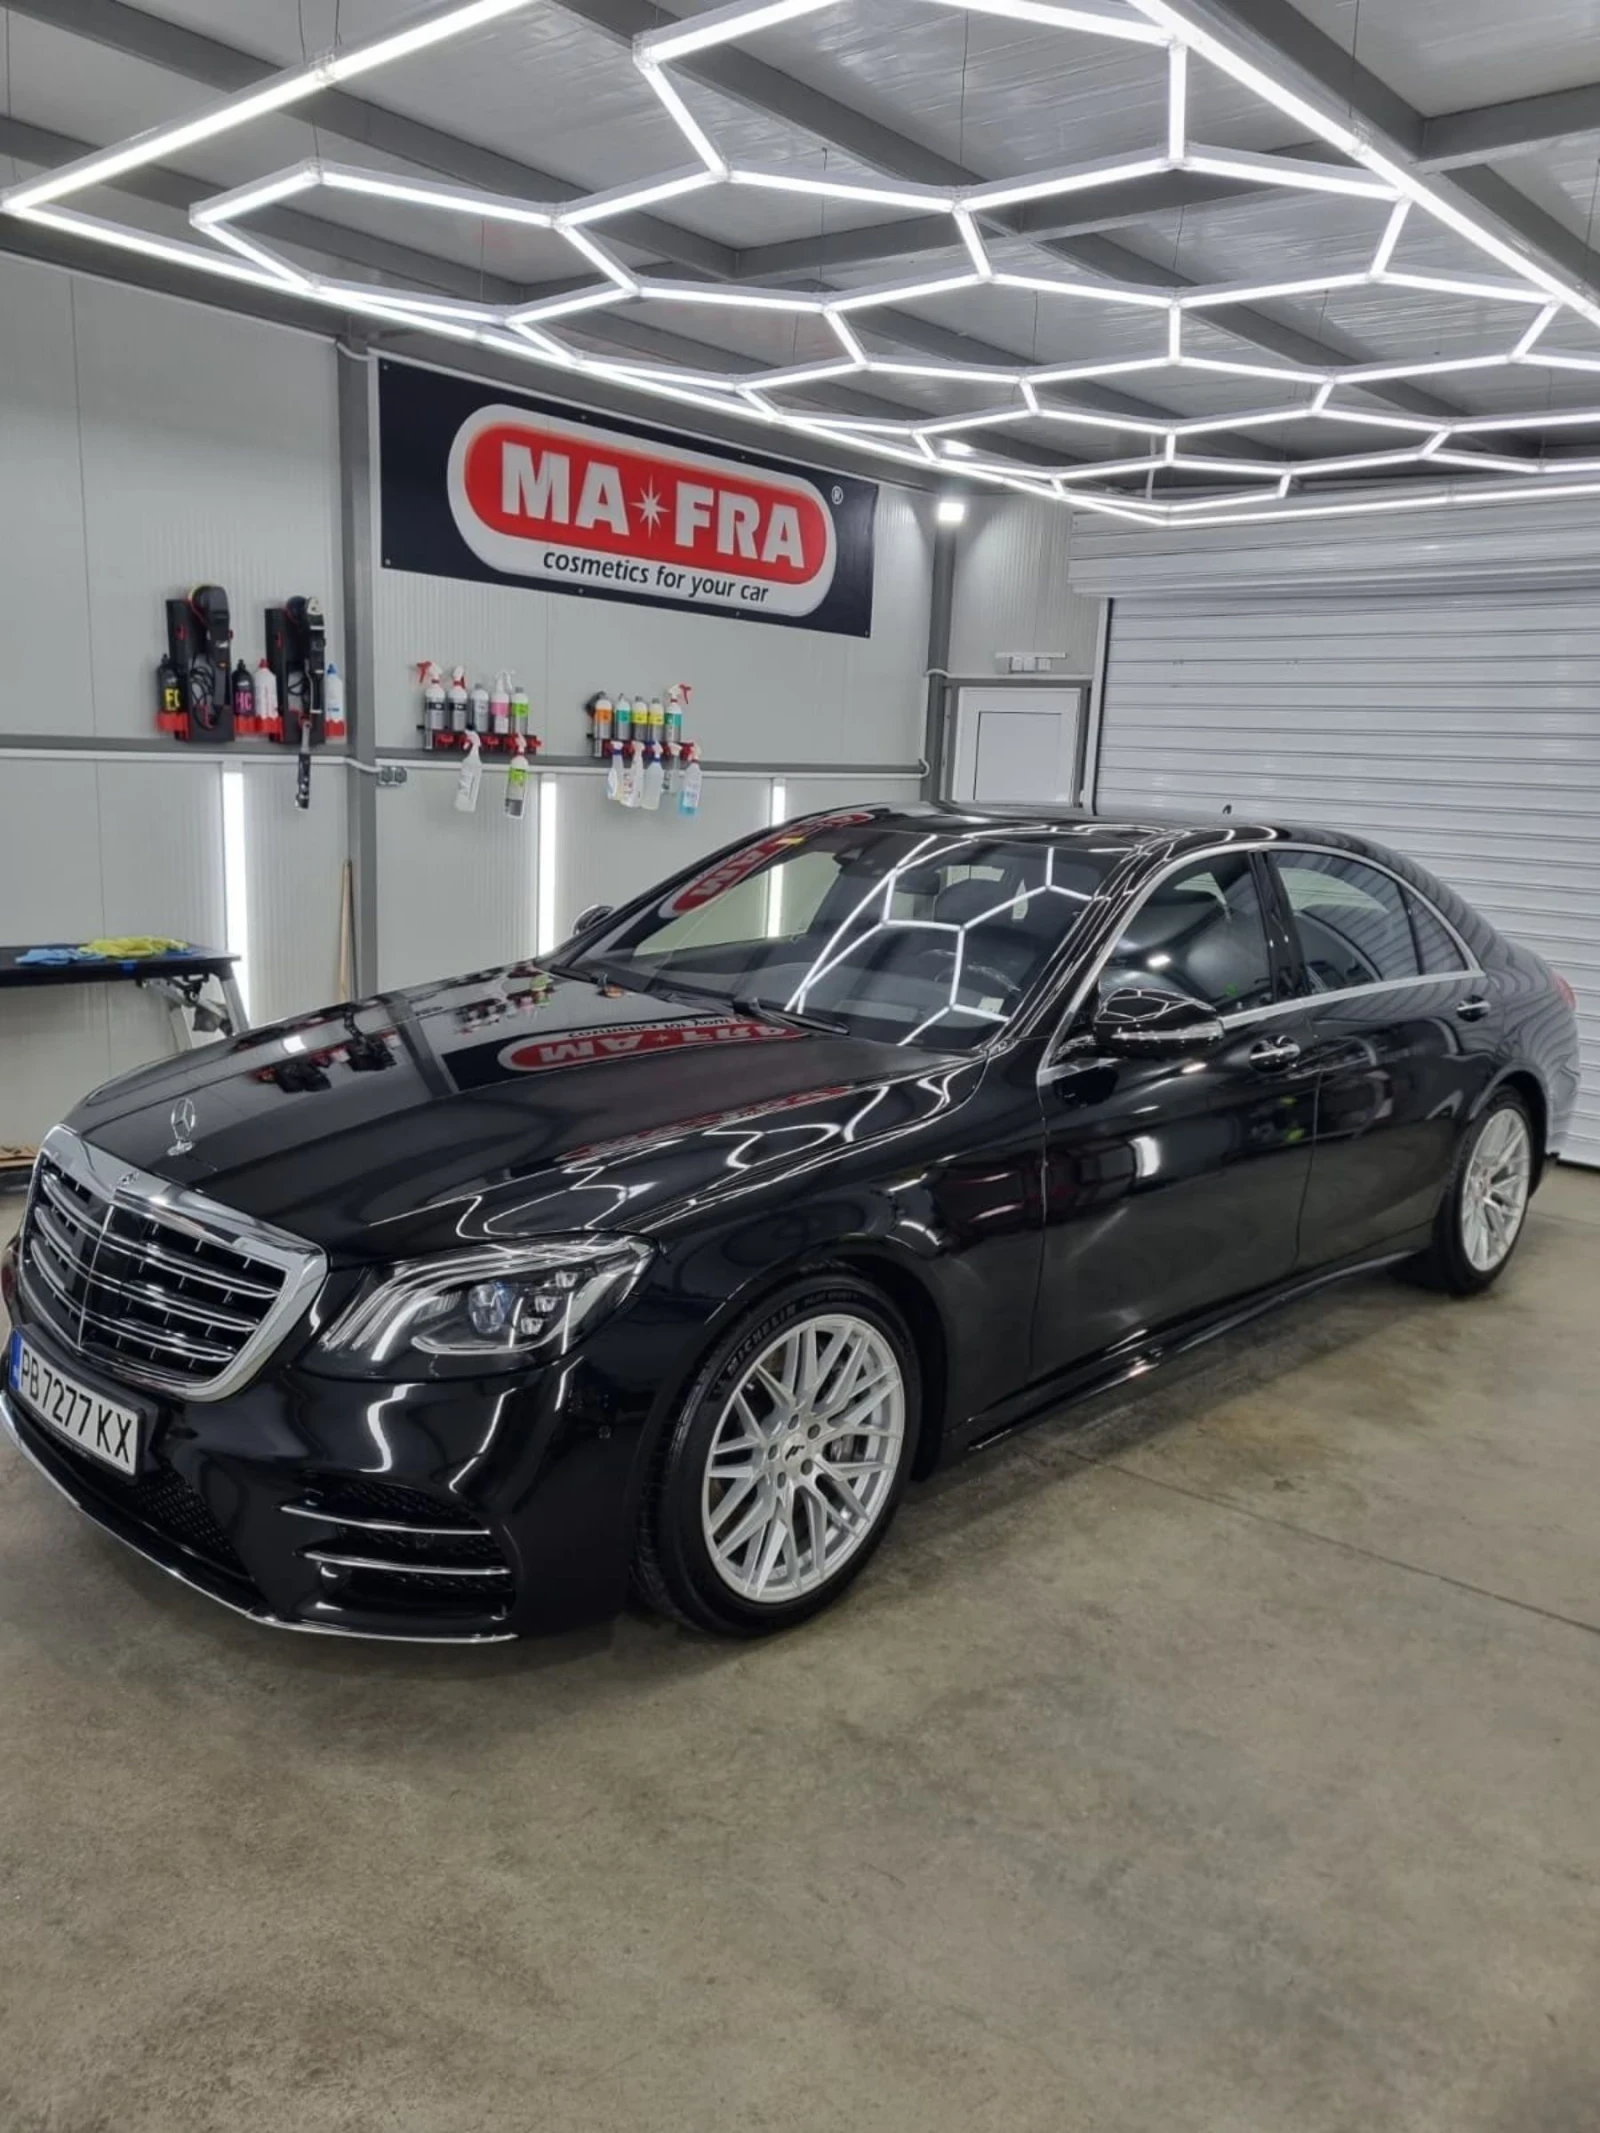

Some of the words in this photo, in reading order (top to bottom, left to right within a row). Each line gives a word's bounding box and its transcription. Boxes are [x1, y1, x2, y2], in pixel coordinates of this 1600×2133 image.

[502, 441, 630, 536] MA
[675, 480, 805, 569] FRA
[543, 550, 650, 584] cosmetics
[656, 565, 686, 589] for
[688, 575, 735, 598] your
[740, 583, 769, 603] car
